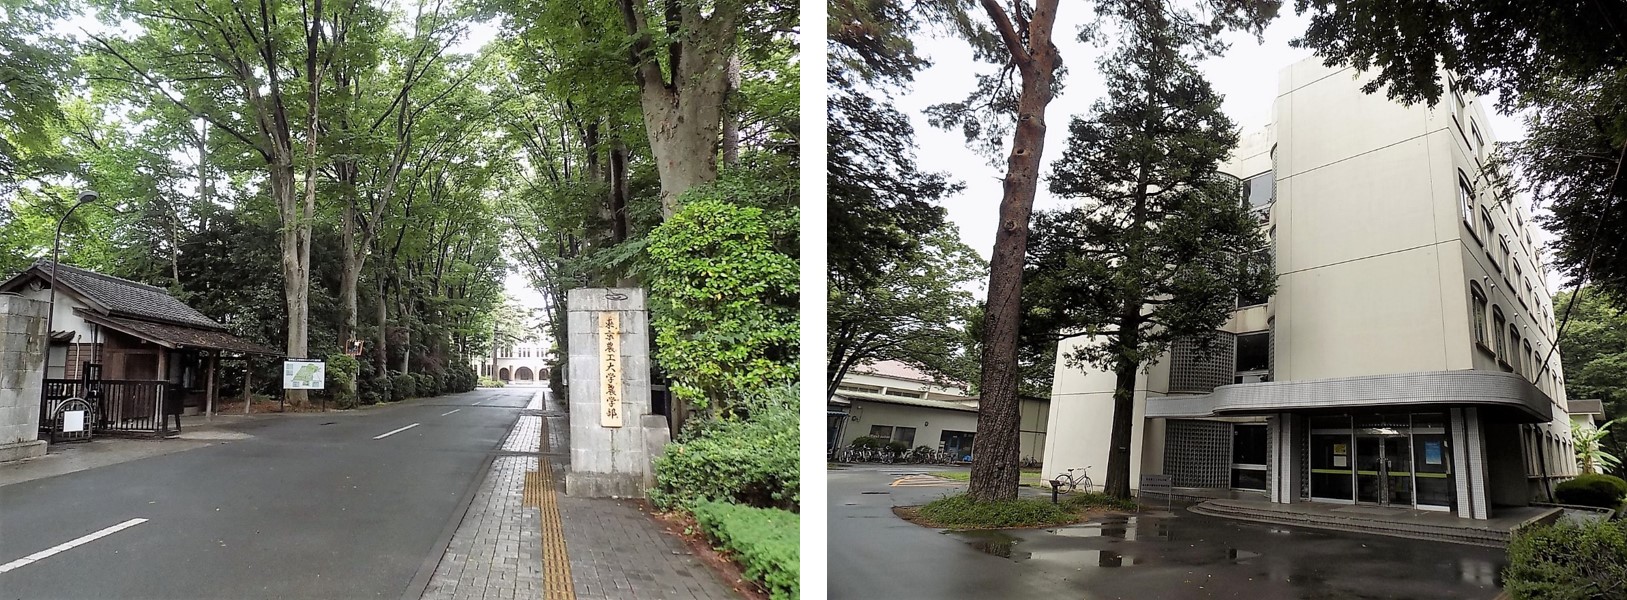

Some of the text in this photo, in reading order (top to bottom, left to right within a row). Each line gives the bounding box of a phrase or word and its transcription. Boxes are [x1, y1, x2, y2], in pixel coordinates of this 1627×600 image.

[604, 317, 617, 419] 東京農工大学農学部
